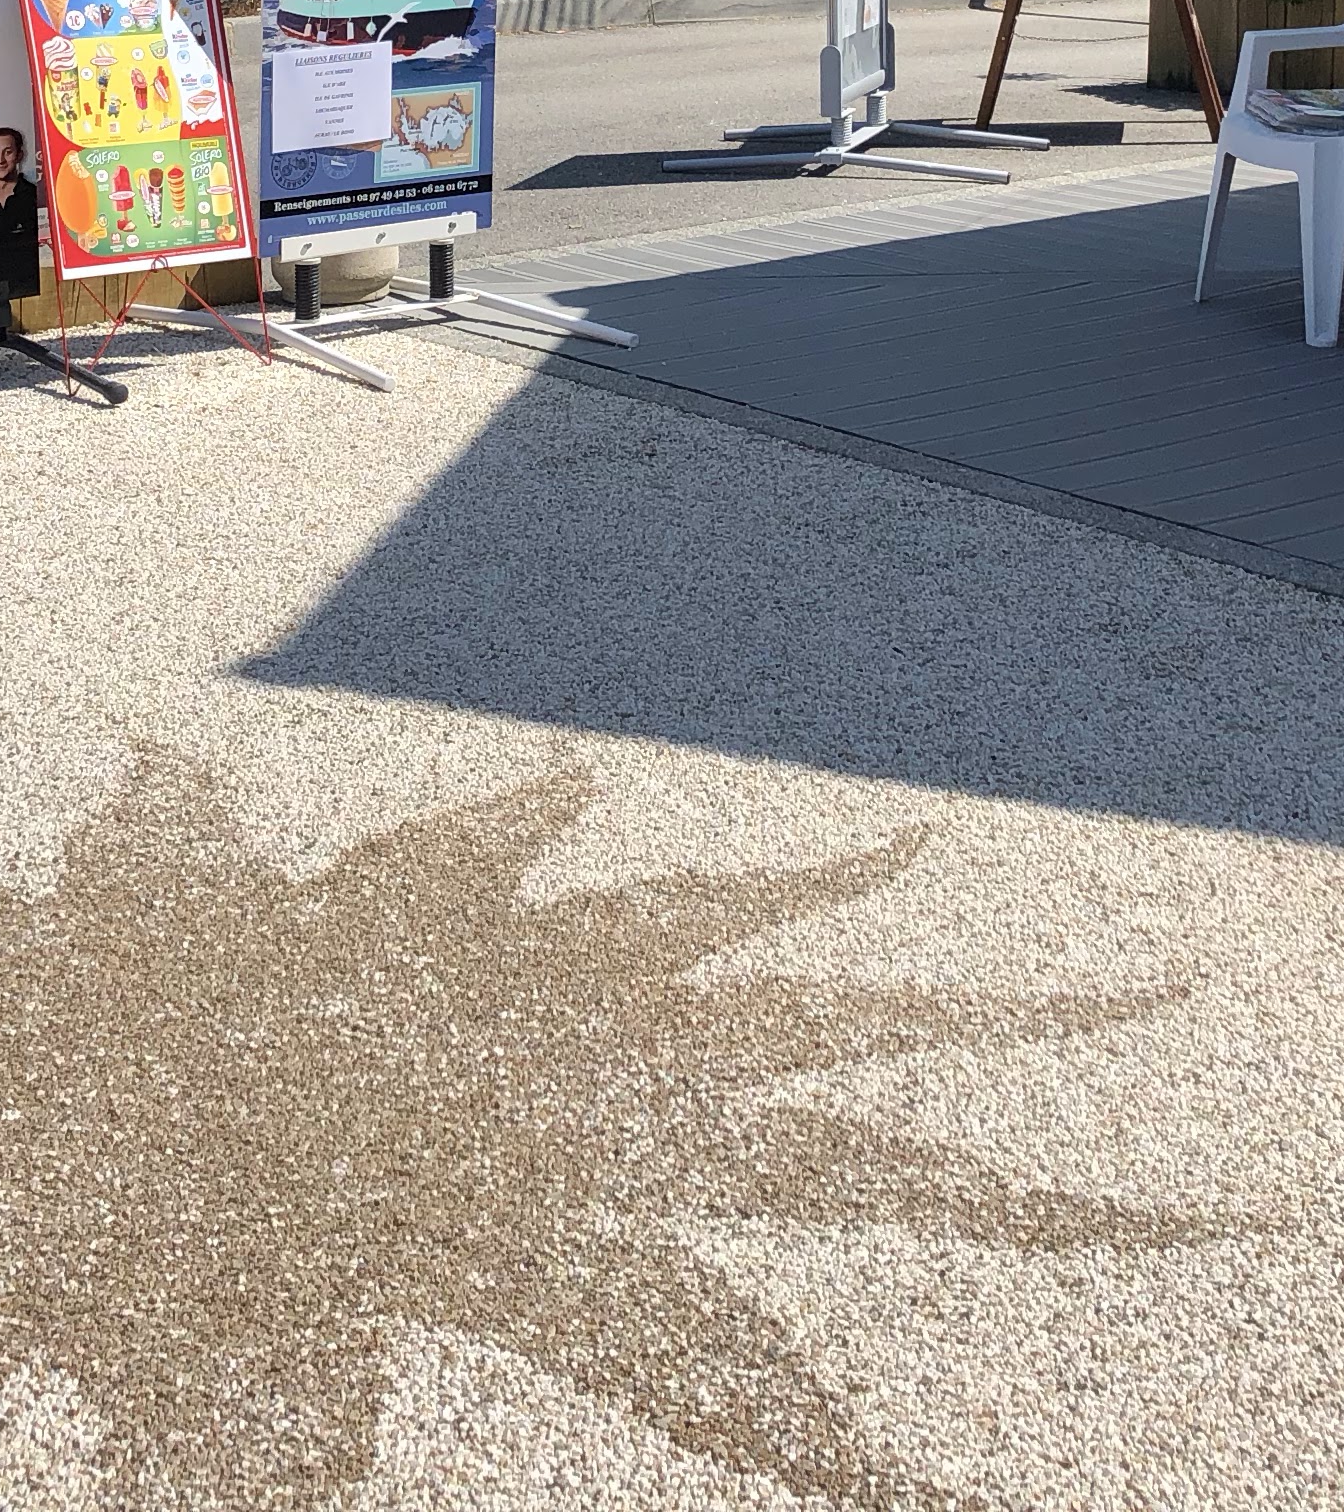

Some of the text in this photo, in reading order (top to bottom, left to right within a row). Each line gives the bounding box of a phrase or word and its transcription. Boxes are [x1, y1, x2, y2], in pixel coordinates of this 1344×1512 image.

[85, 150, 120, 168] SOLERO
[188, 148, 223, 165] SOLERO
[273, 194, 351, 213] Renseignements
[356, 193, 369, 203] 02
[369, 191, 380, 203] 97
[381, 191, 393, 201] 49
[422, 184, 433, 195] 06
[307, 199, 448, 226] www.passeurdesiles.com
